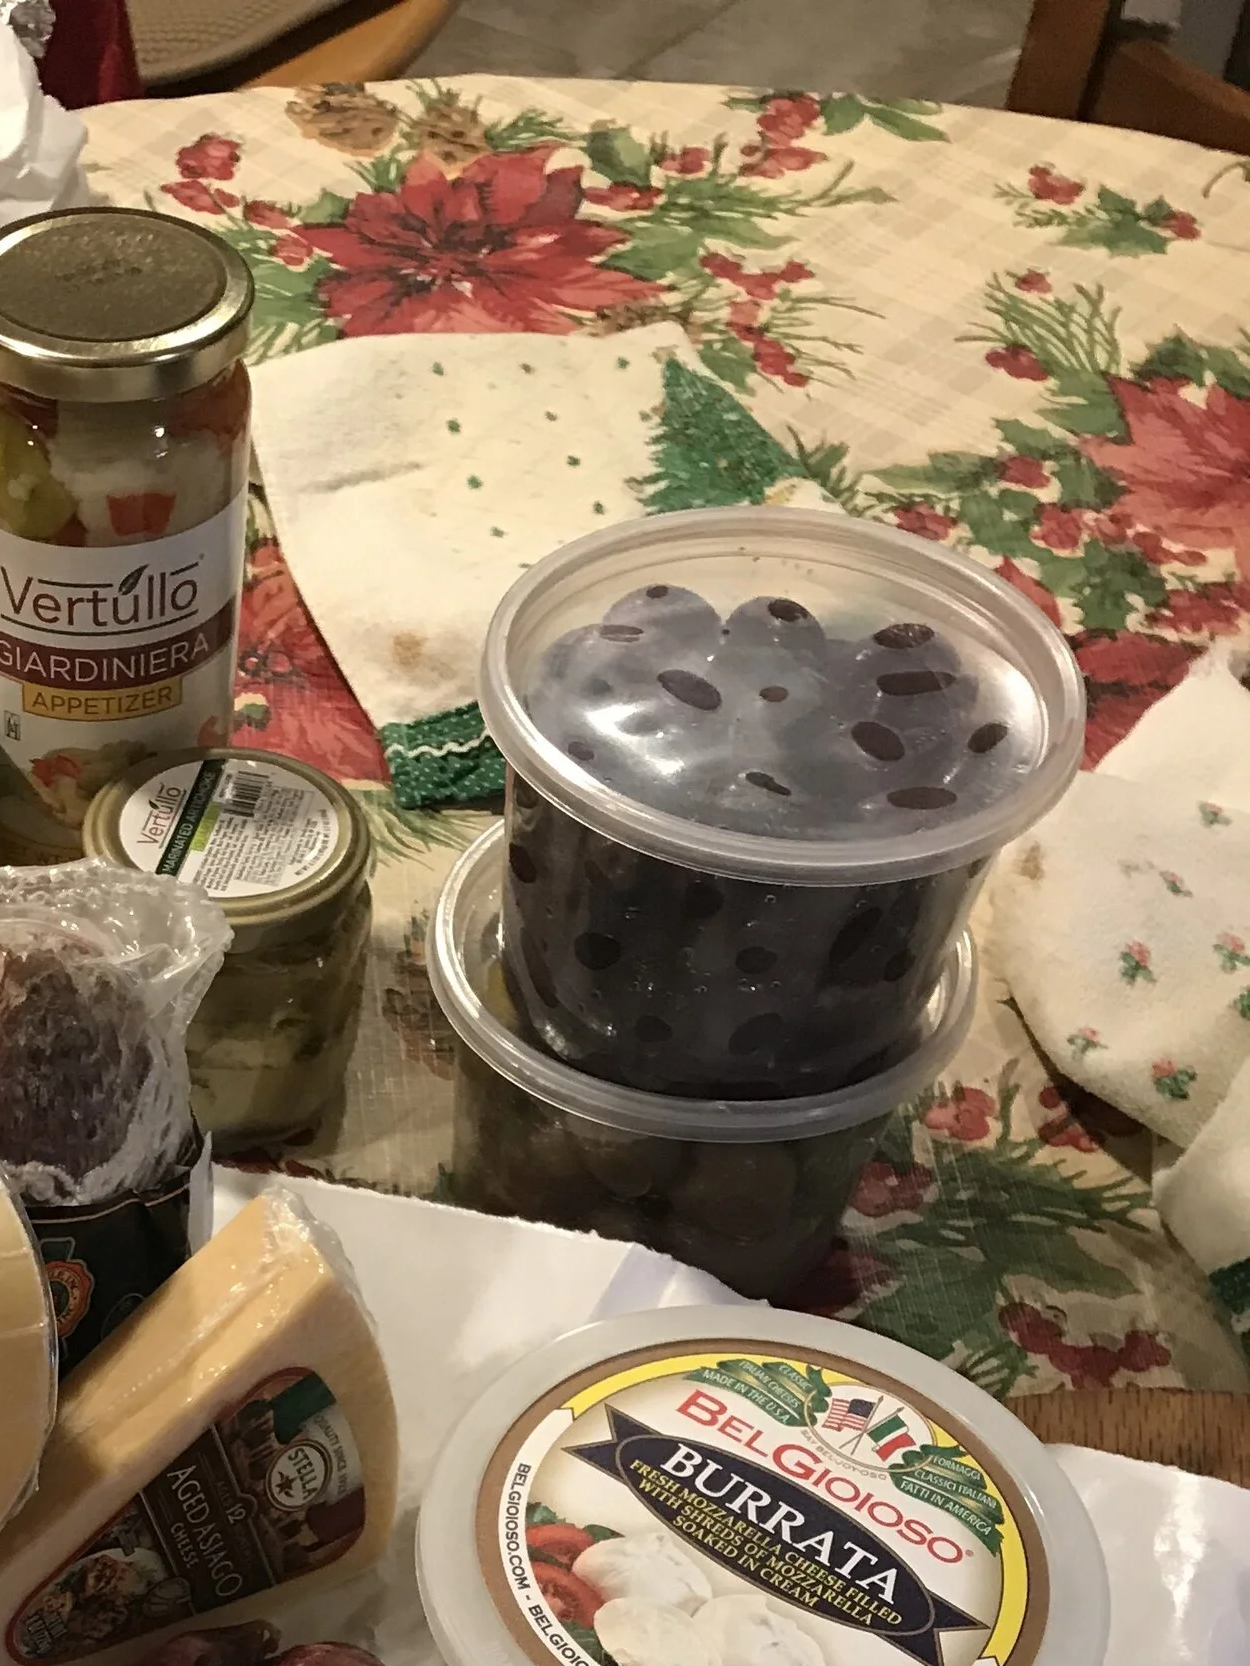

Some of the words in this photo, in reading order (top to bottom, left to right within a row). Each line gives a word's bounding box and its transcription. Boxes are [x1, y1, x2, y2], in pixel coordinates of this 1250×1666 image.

[31, 686, 172, 717] APPETIZER
[702, 1369, 735, 1387] MADE
[734, 1382, 750, 1394] IN
[746, 1388, 768, 1406] THE
[287, 1447, 319, 1500] STELLA
[913, 1469, 957, 1490] CLASSICI
[933, 1454, 982, 1480] FORMAGGI
[166, 1464, 211, 1525] AGED
[193, 1522, 244, 1598] ASIAGO
[225, 1502, 247, 1525] 12
[506, 1462, 532, 1591] BELGIOIOSO.COM
[660, 1443, 900, 1605] BURRATA
[900, 1480, 932, 1501] FATTI
[929, 1492, 944, 1507] IN
[942, 1499, 993, 1536] AMERICA
[170, 1522, 200, 1569] CHEESE
[630, 1459, 682, 1493] FRESH
[679, 1487, 782, 1559] MOZZARELLA
[784, 1550, 847, 1594] CHEESE
[845, 1587, 904, 1626] FILLED
[638, 1478, 681, 1511] WITH
[680, 1504, 743, 1549] SHREDS
[743, 1542, 770, 1562] OF
[766, 1556, 874, 1626] MOZZARELLA
[672, 1515, 739, 1560] SOAKED
[737, 1553, 758, 1574] IN
[759, 1567, 820, 1609] CREAM
